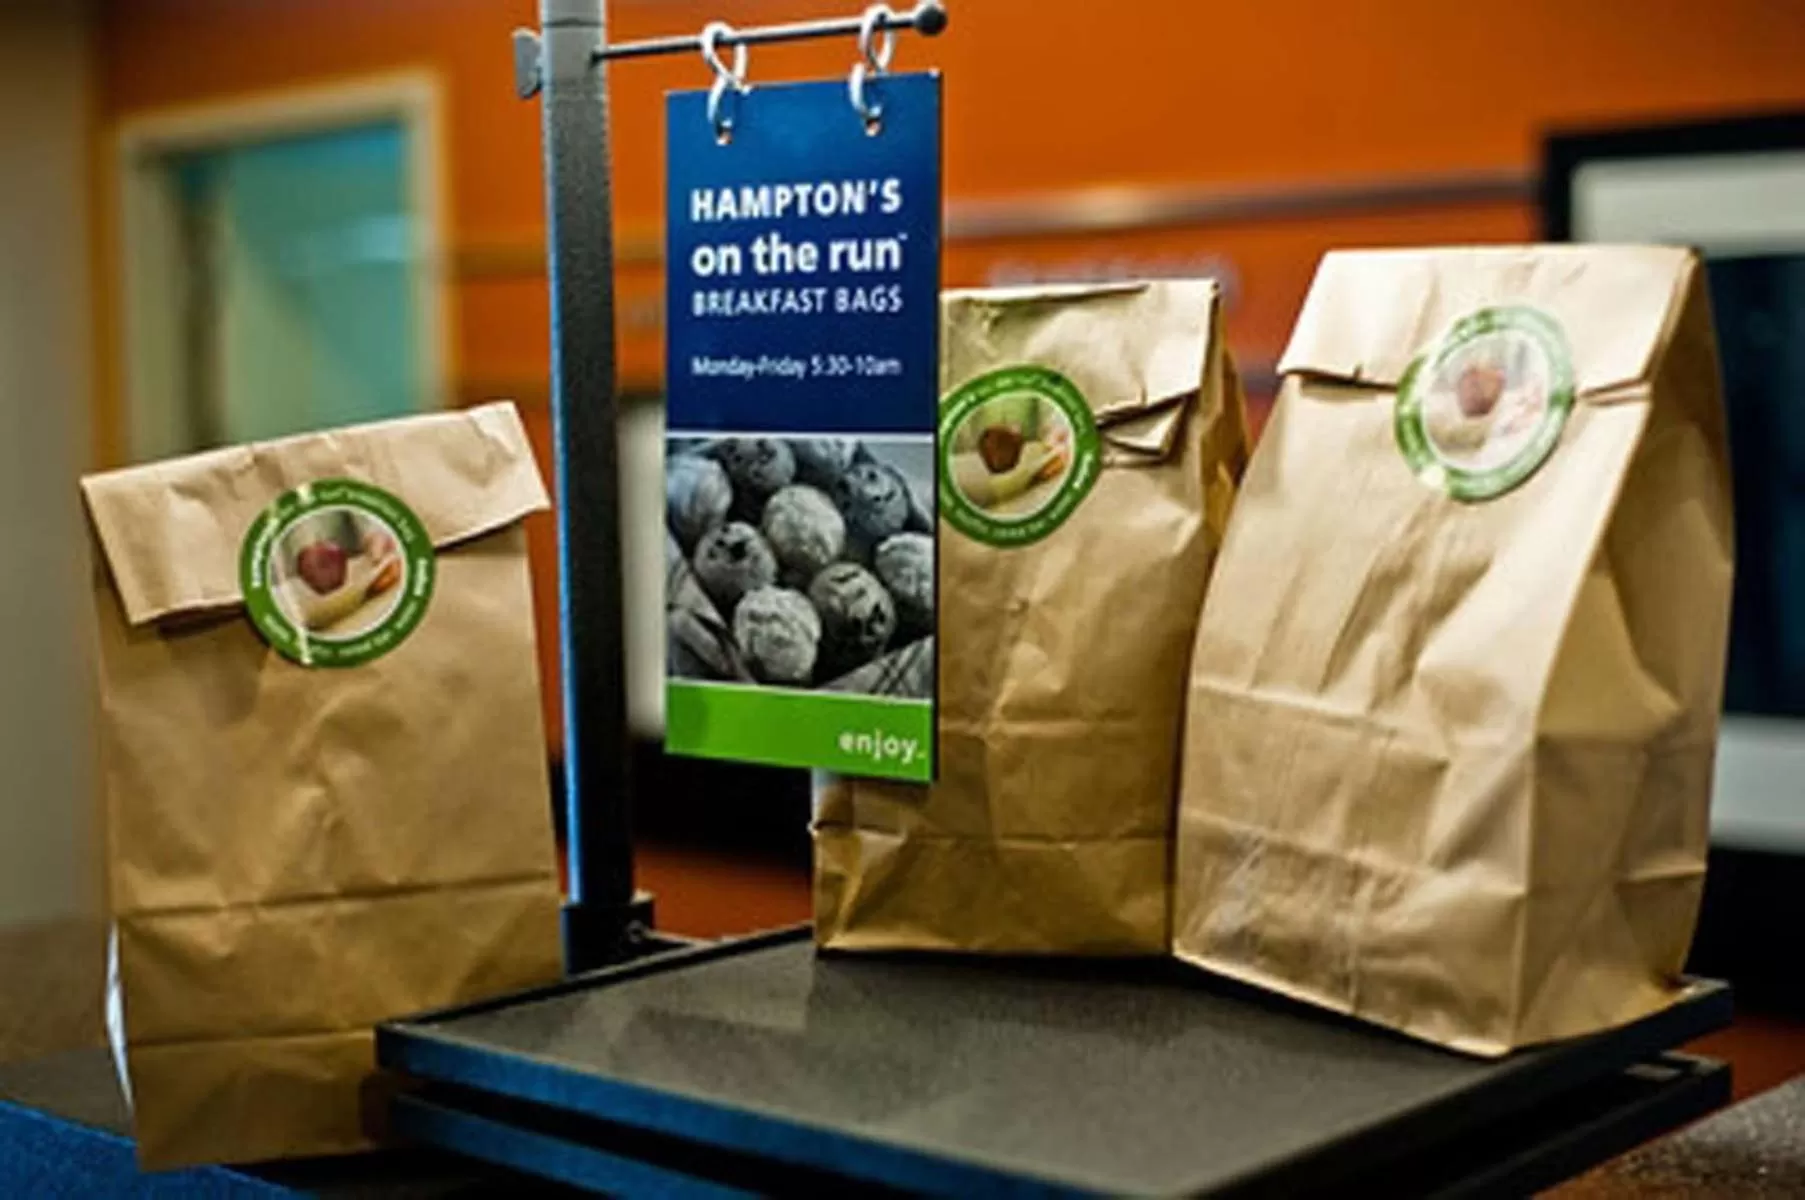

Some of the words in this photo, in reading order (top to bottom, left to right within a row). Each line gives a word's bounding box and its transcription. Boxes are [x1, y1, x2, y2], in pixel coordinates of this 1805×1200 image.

[690, 177, 903, 222] HAMPTON'S
[691, 243, 743, 277] on
[750, 230, 820, 275] the
[691, 287, 828, 317] BREAKFAST
[834, 284, 904, 313] BAGS
